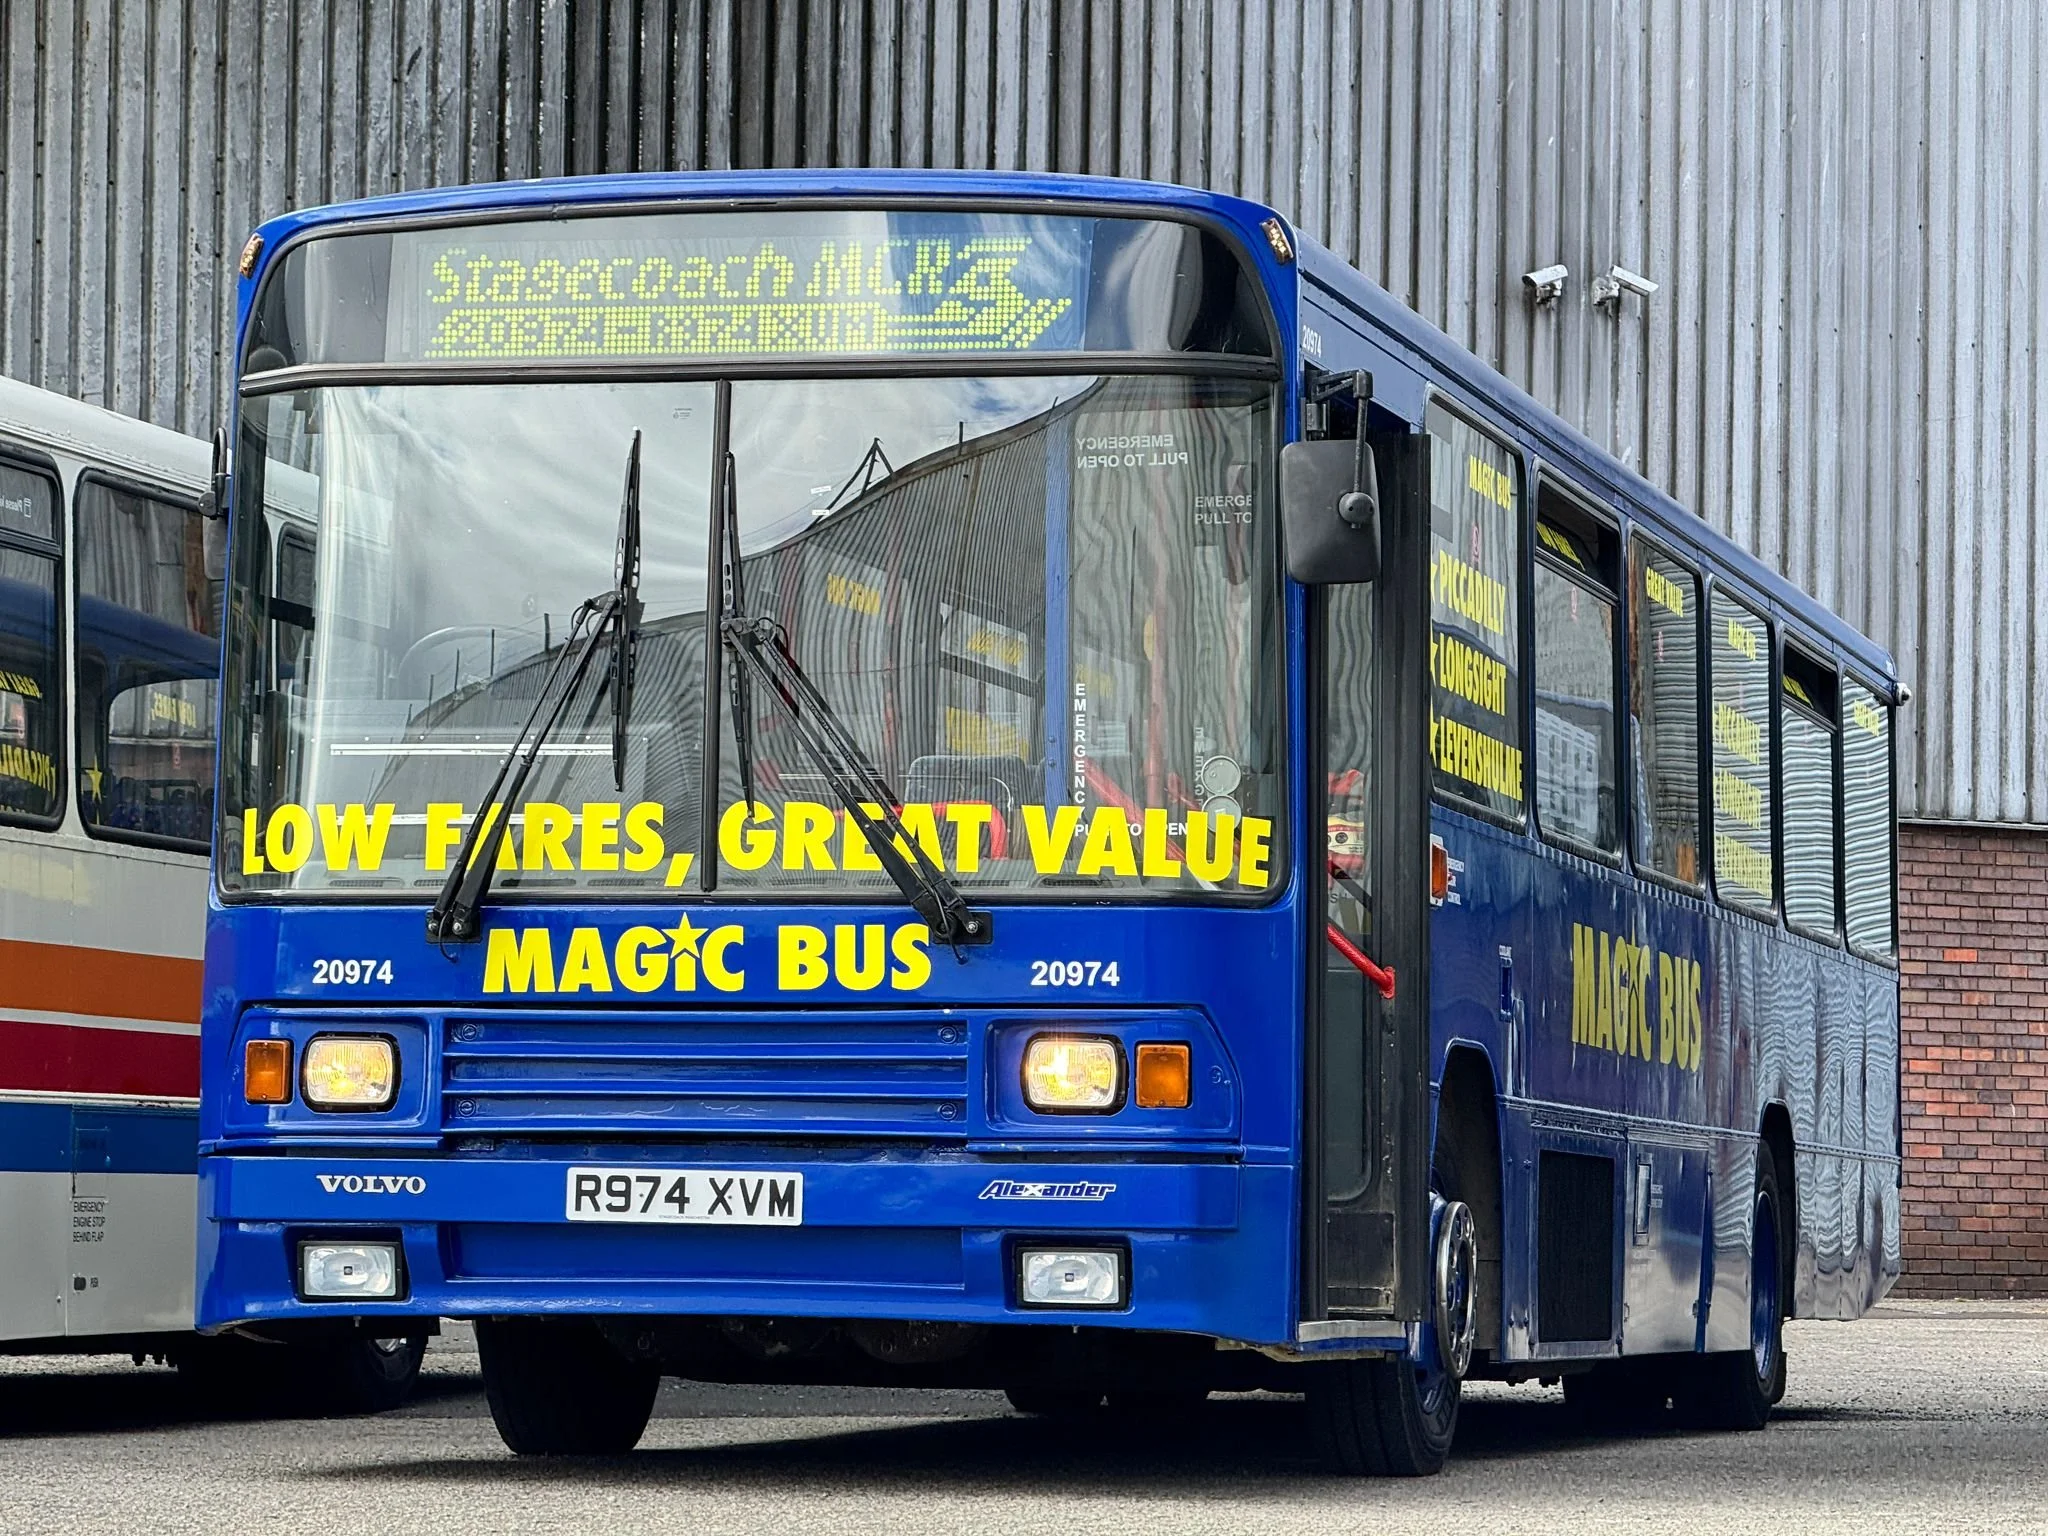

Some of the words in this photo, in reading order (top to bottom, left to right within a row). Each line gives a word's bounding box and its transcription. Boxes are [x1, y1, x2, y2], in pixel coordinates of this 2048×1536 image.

[426, 241, 794, 303] Stagecoach
[1302, 324, 1322, 358] 20974
[1469, 454, 1496, 502] MAGIC
[1497, 471, 1512, 511] BUS
[1195, 511, 1231, 525] PULL
[1439, 550, 1506, 637] PICCADILLY
[1439, 632, 1507, 717] LONGSIGHT
[1440, 715, 1524, 802] LEVENSHULME
[243, 802, 396, 876] LOW
[425, 801, 695, 888] FARES,
[718, 799, 992, 873] GREAT
[1022, 804, 1272, 888] VALUE
[482, 911, 745, 994] MAGIC
[777, 922, 933, 991] BUS
[312, 959, 394, 986] 20974
[1030, 960, 1121, 987] 20974
[1572, 908, 1652, 1062] MAGIC
[1659, 951, 1702, 1073] BUS
[316, 1174, 427, 1195] VOLVO
[574, 1173, 691, 1215] R974
[707, 1176, 796, 1218] XVM
[978, 1179, 1117, 1201] Alexander
[73, 1201, 104, 1212] EMERGENCY
[73, 1216, 91, 1227] ENGINE
[92, 1216, 106, 1227] STOP
[72, 1231, 91, 1242] BEHIND
[92, 1231, 104, 1242] FLAP
